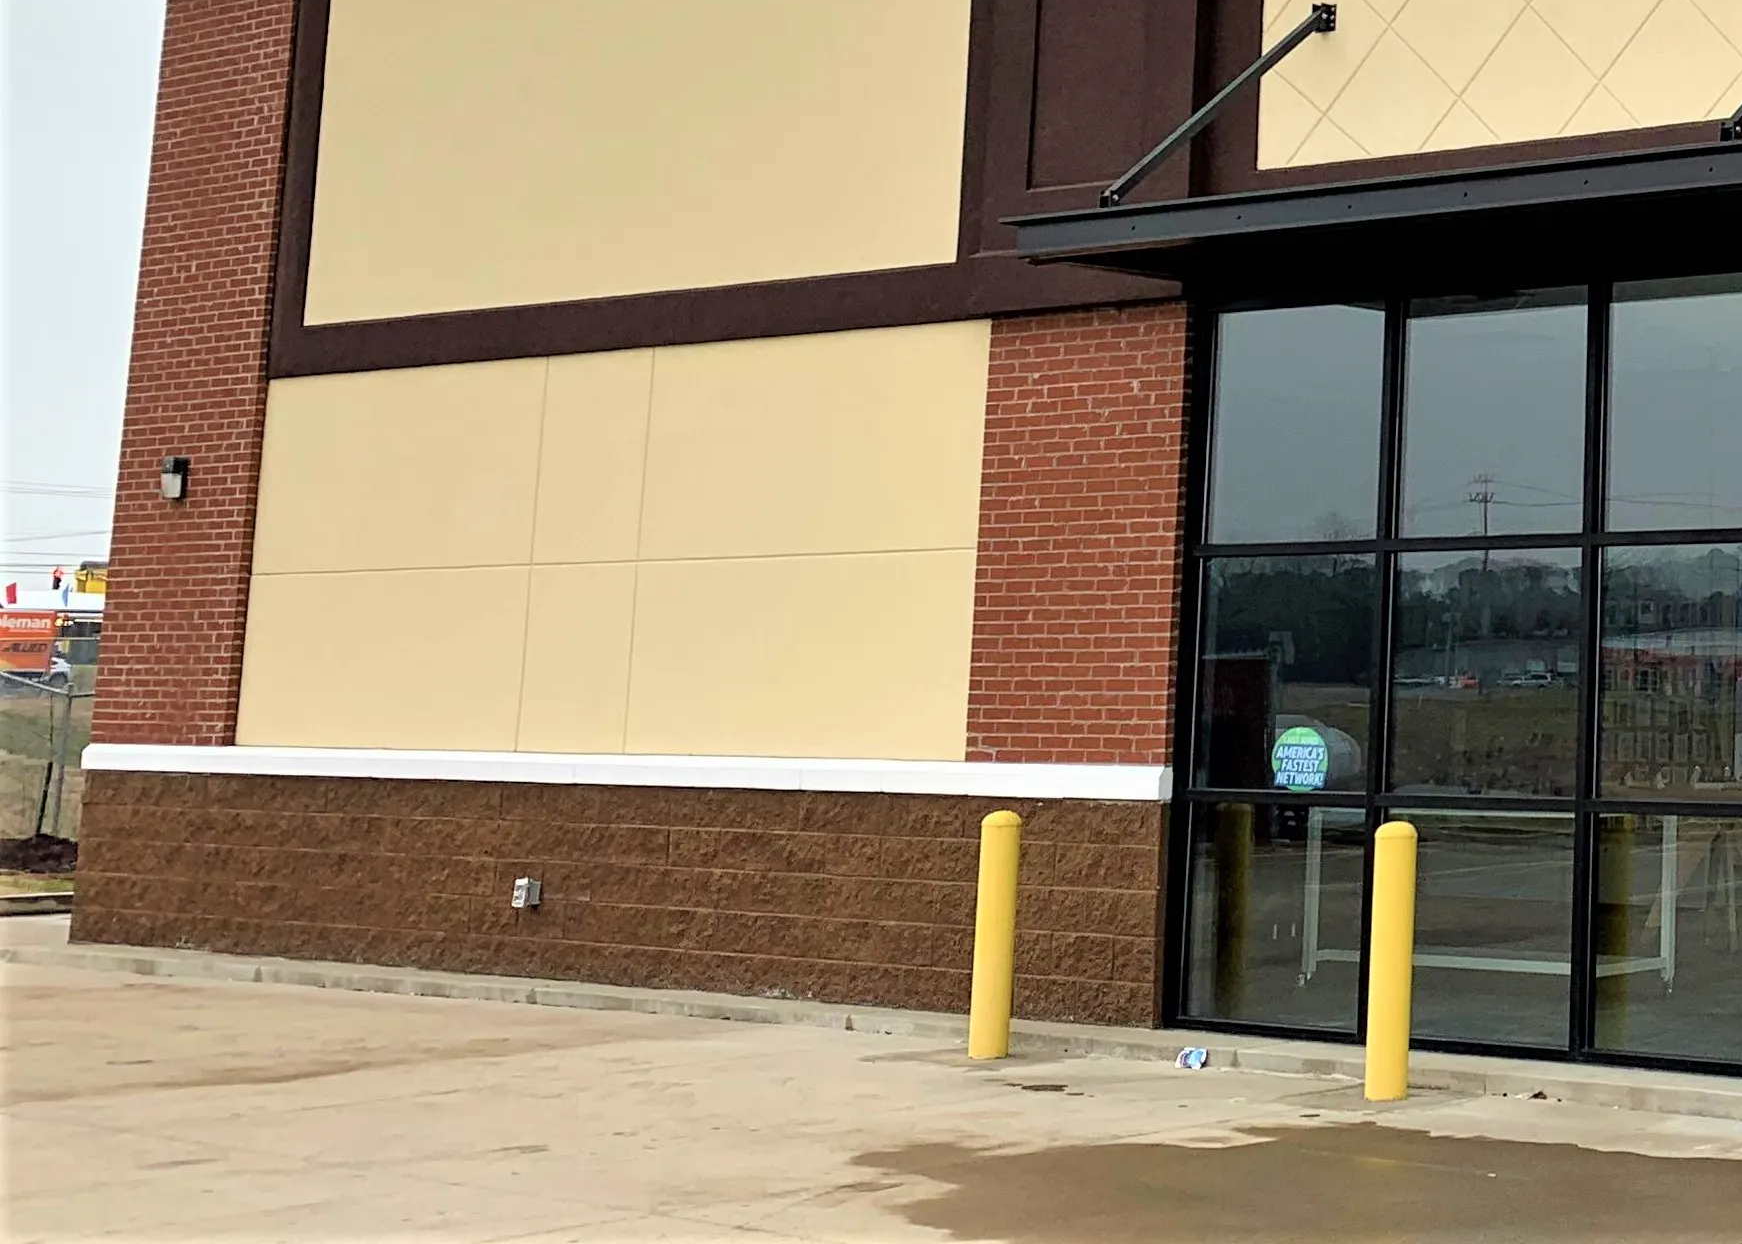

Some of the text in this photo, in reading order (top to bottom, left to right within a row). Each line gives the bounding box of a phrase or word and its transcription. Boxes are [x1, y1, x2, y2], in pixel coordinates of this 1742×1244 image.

[1275, 745, 1325, 760] AMERICA'S
[1281, 759, 1320, 772] FASTEST
[1275, 771, 1324, 786] NETWORK!
